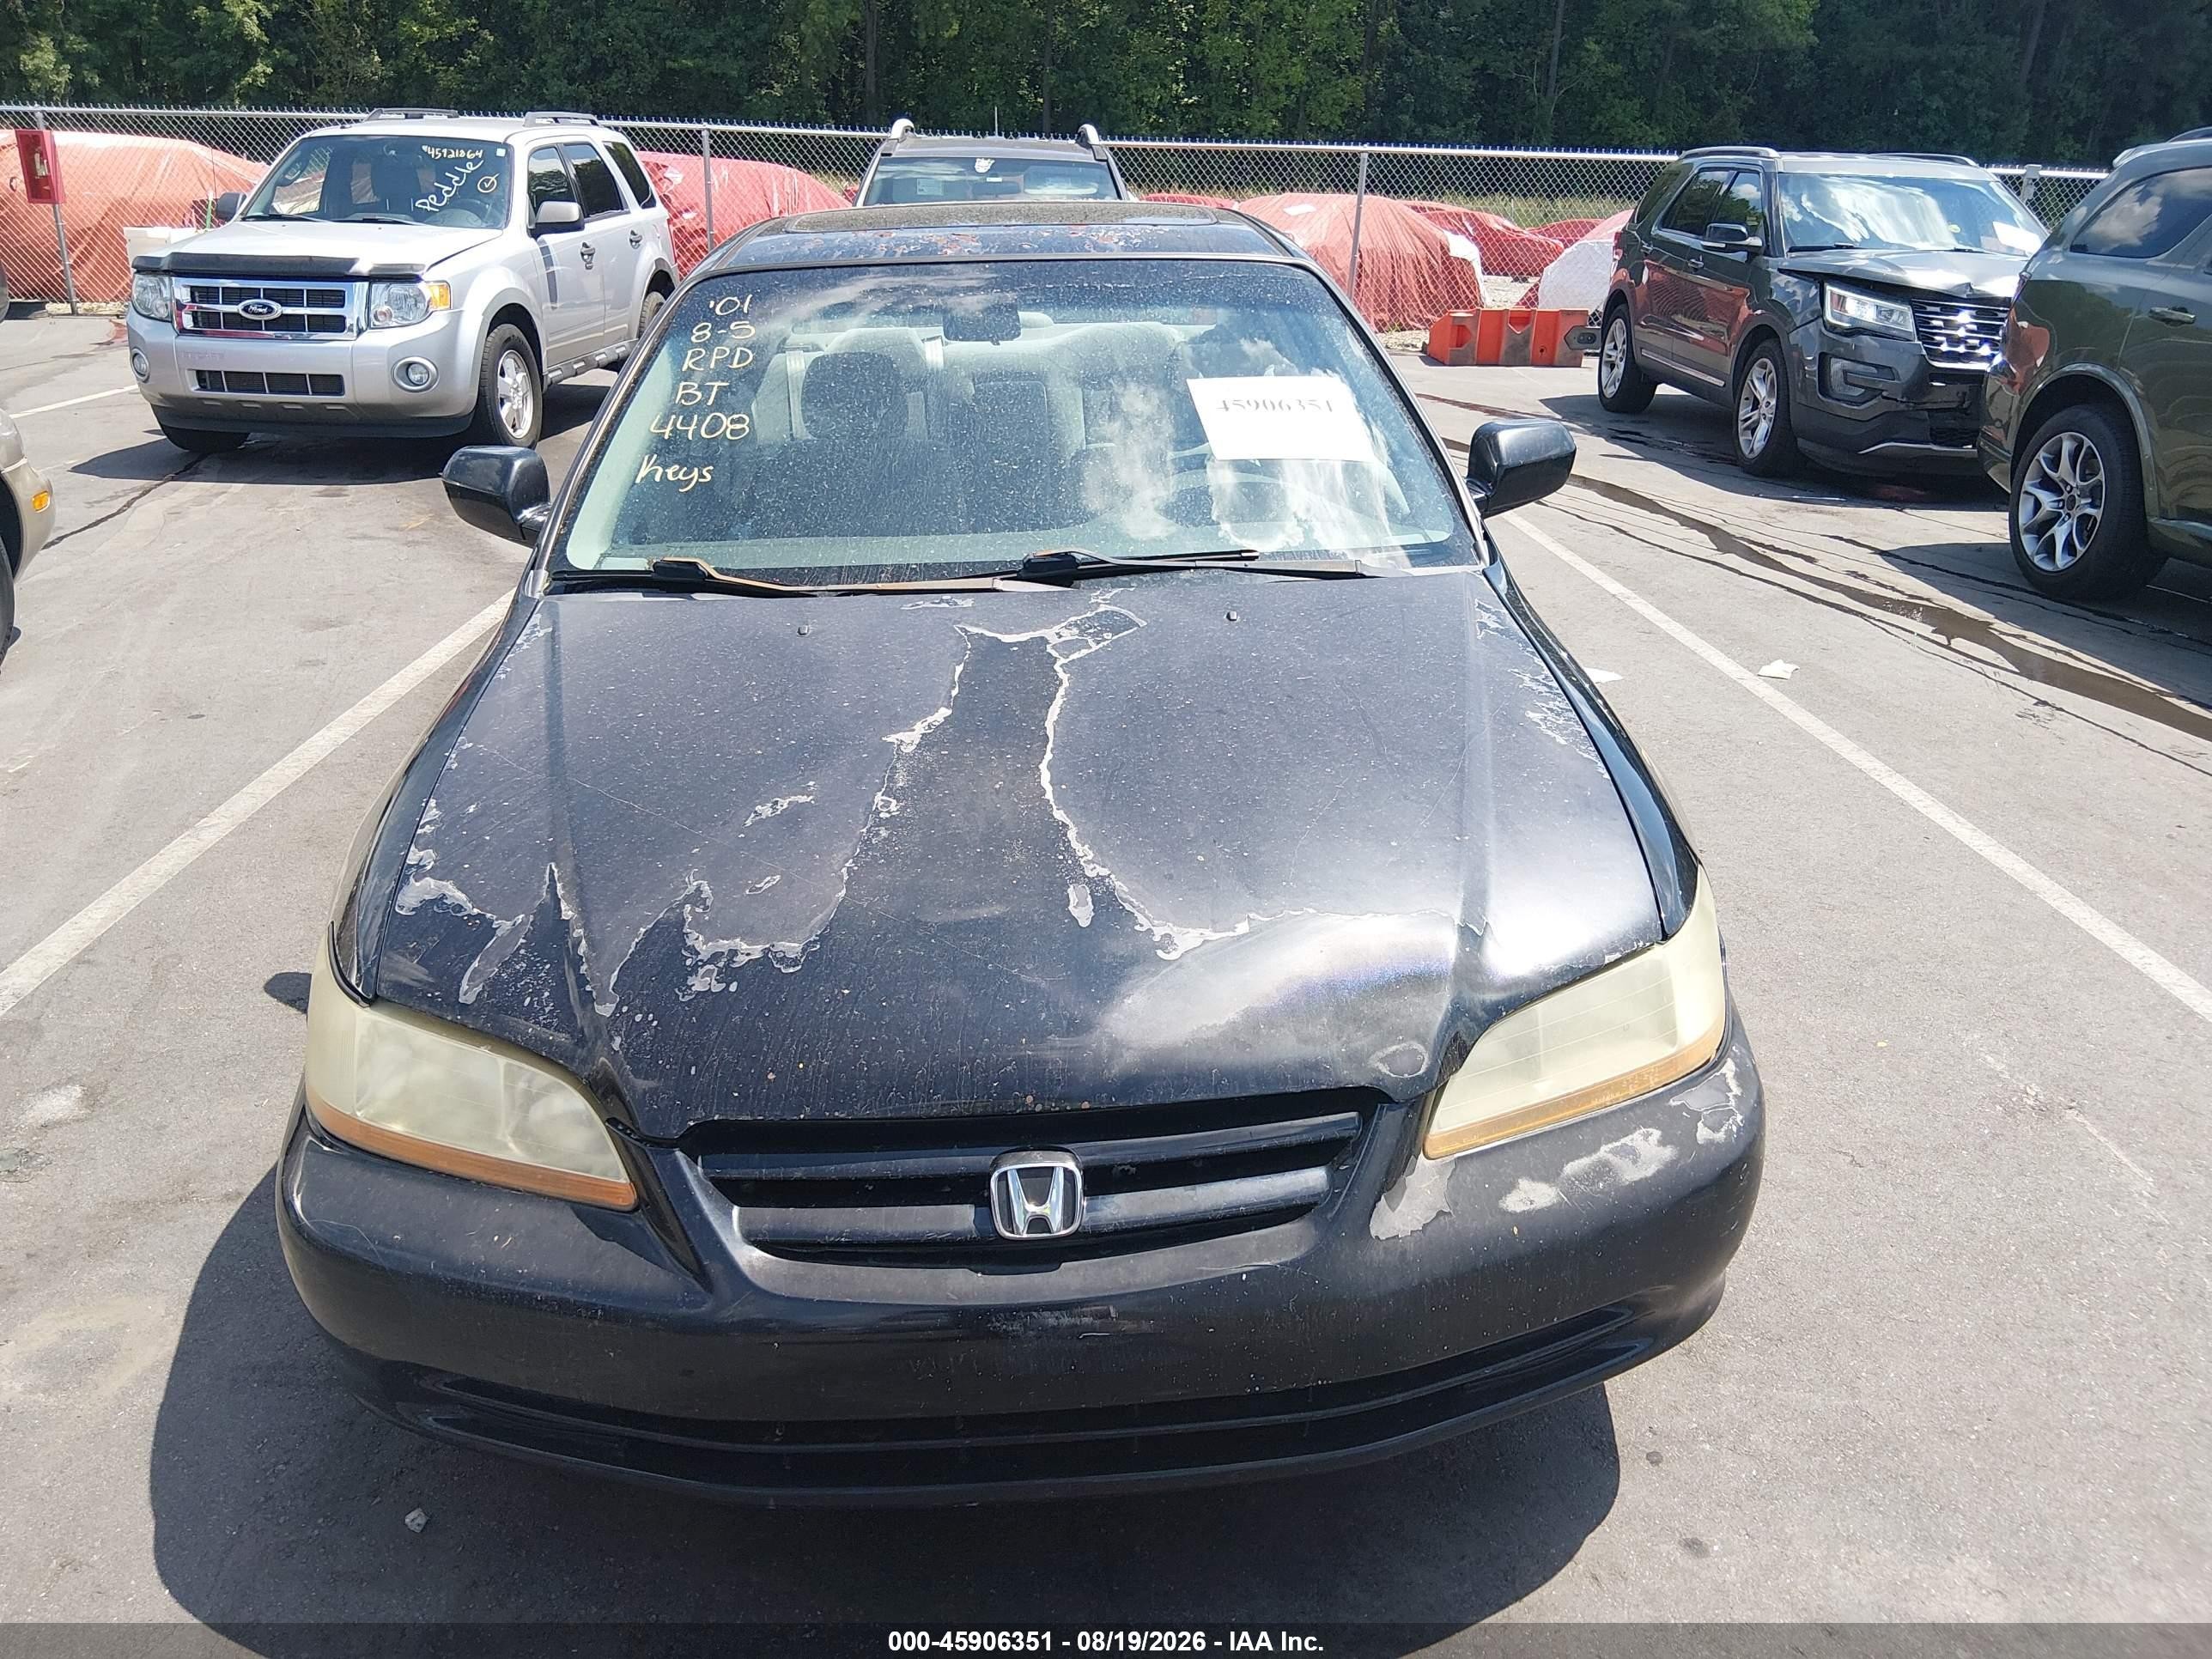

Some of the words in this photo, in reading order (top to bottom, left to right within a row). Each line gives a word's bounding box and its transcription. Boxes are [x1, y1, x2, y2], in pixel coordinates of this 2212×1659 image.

[682, 346, 753, 372] RPD
[675, 382, 729, 406] BT
[649, 411, 750, 441] 4408
